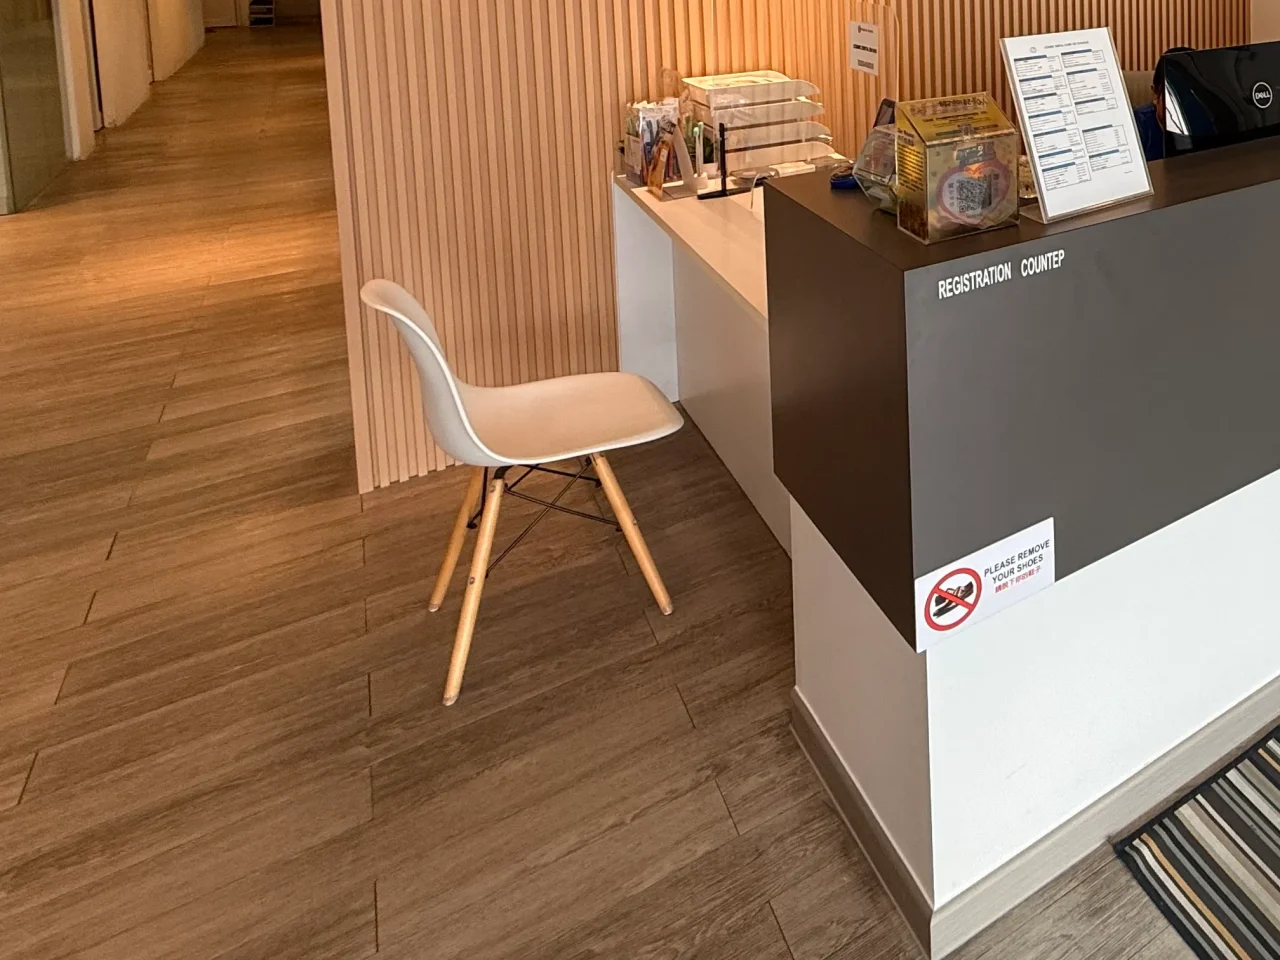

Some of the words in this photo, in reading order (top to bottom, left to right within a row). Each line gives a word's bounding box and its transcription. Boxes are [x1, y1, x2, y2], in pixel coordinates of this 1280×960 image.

[1254, 91, 1271, 100] DELL
[938, 261, 1012, 300] REGISTRATION
[983, 556, 1016, 577] PLEASE
[1017, 539, 1050, 562] REMOVE
[991, 567, 1015, 585] YOUR
[1016, 553, 1044, 573] SHOES
